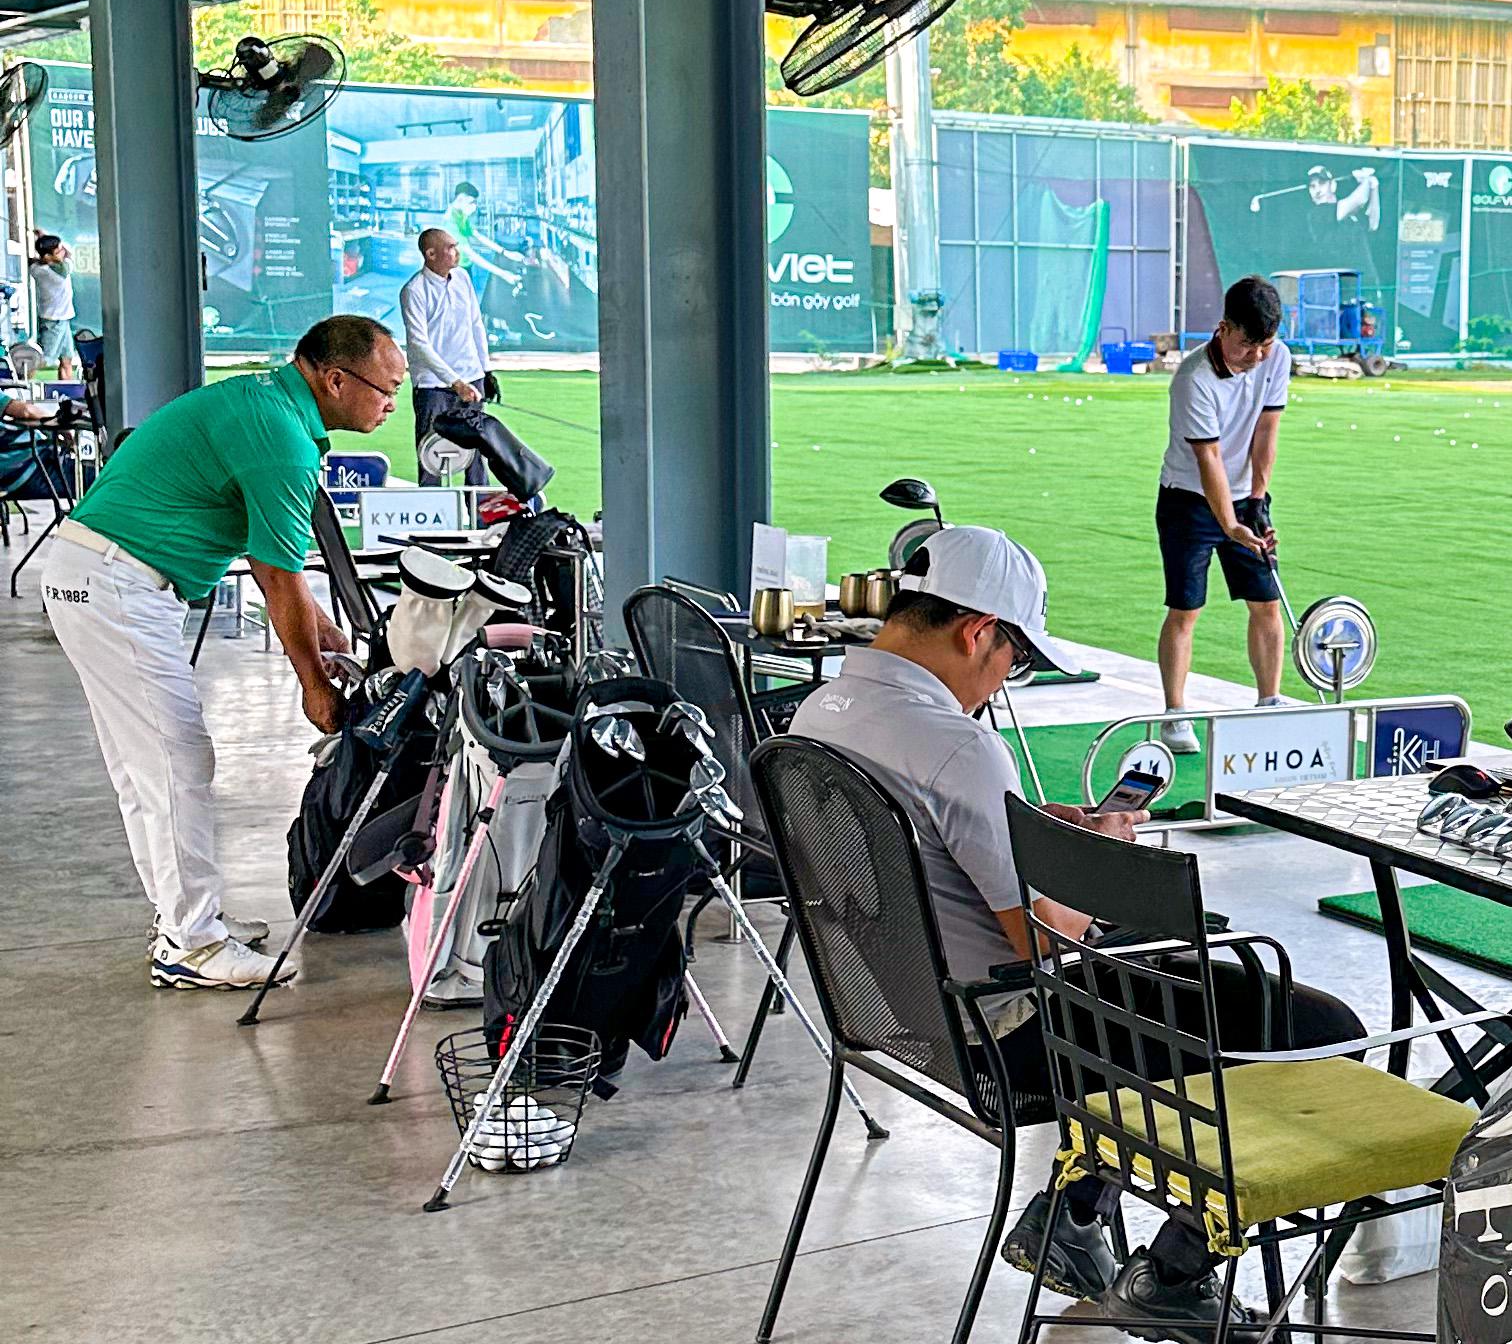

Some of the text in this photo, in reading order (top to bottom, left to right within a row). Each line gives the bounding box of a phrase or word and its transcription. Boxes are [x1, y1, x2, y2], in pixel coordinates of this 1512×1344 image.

[51, 108, 83, 128] OUR
[52, 128, 95, 148] HAVE
[832, 293, 860, 310] golf
[371, 512, 443, 526] KYHOA
[1222, 747, 1325, 775] KYHOA
